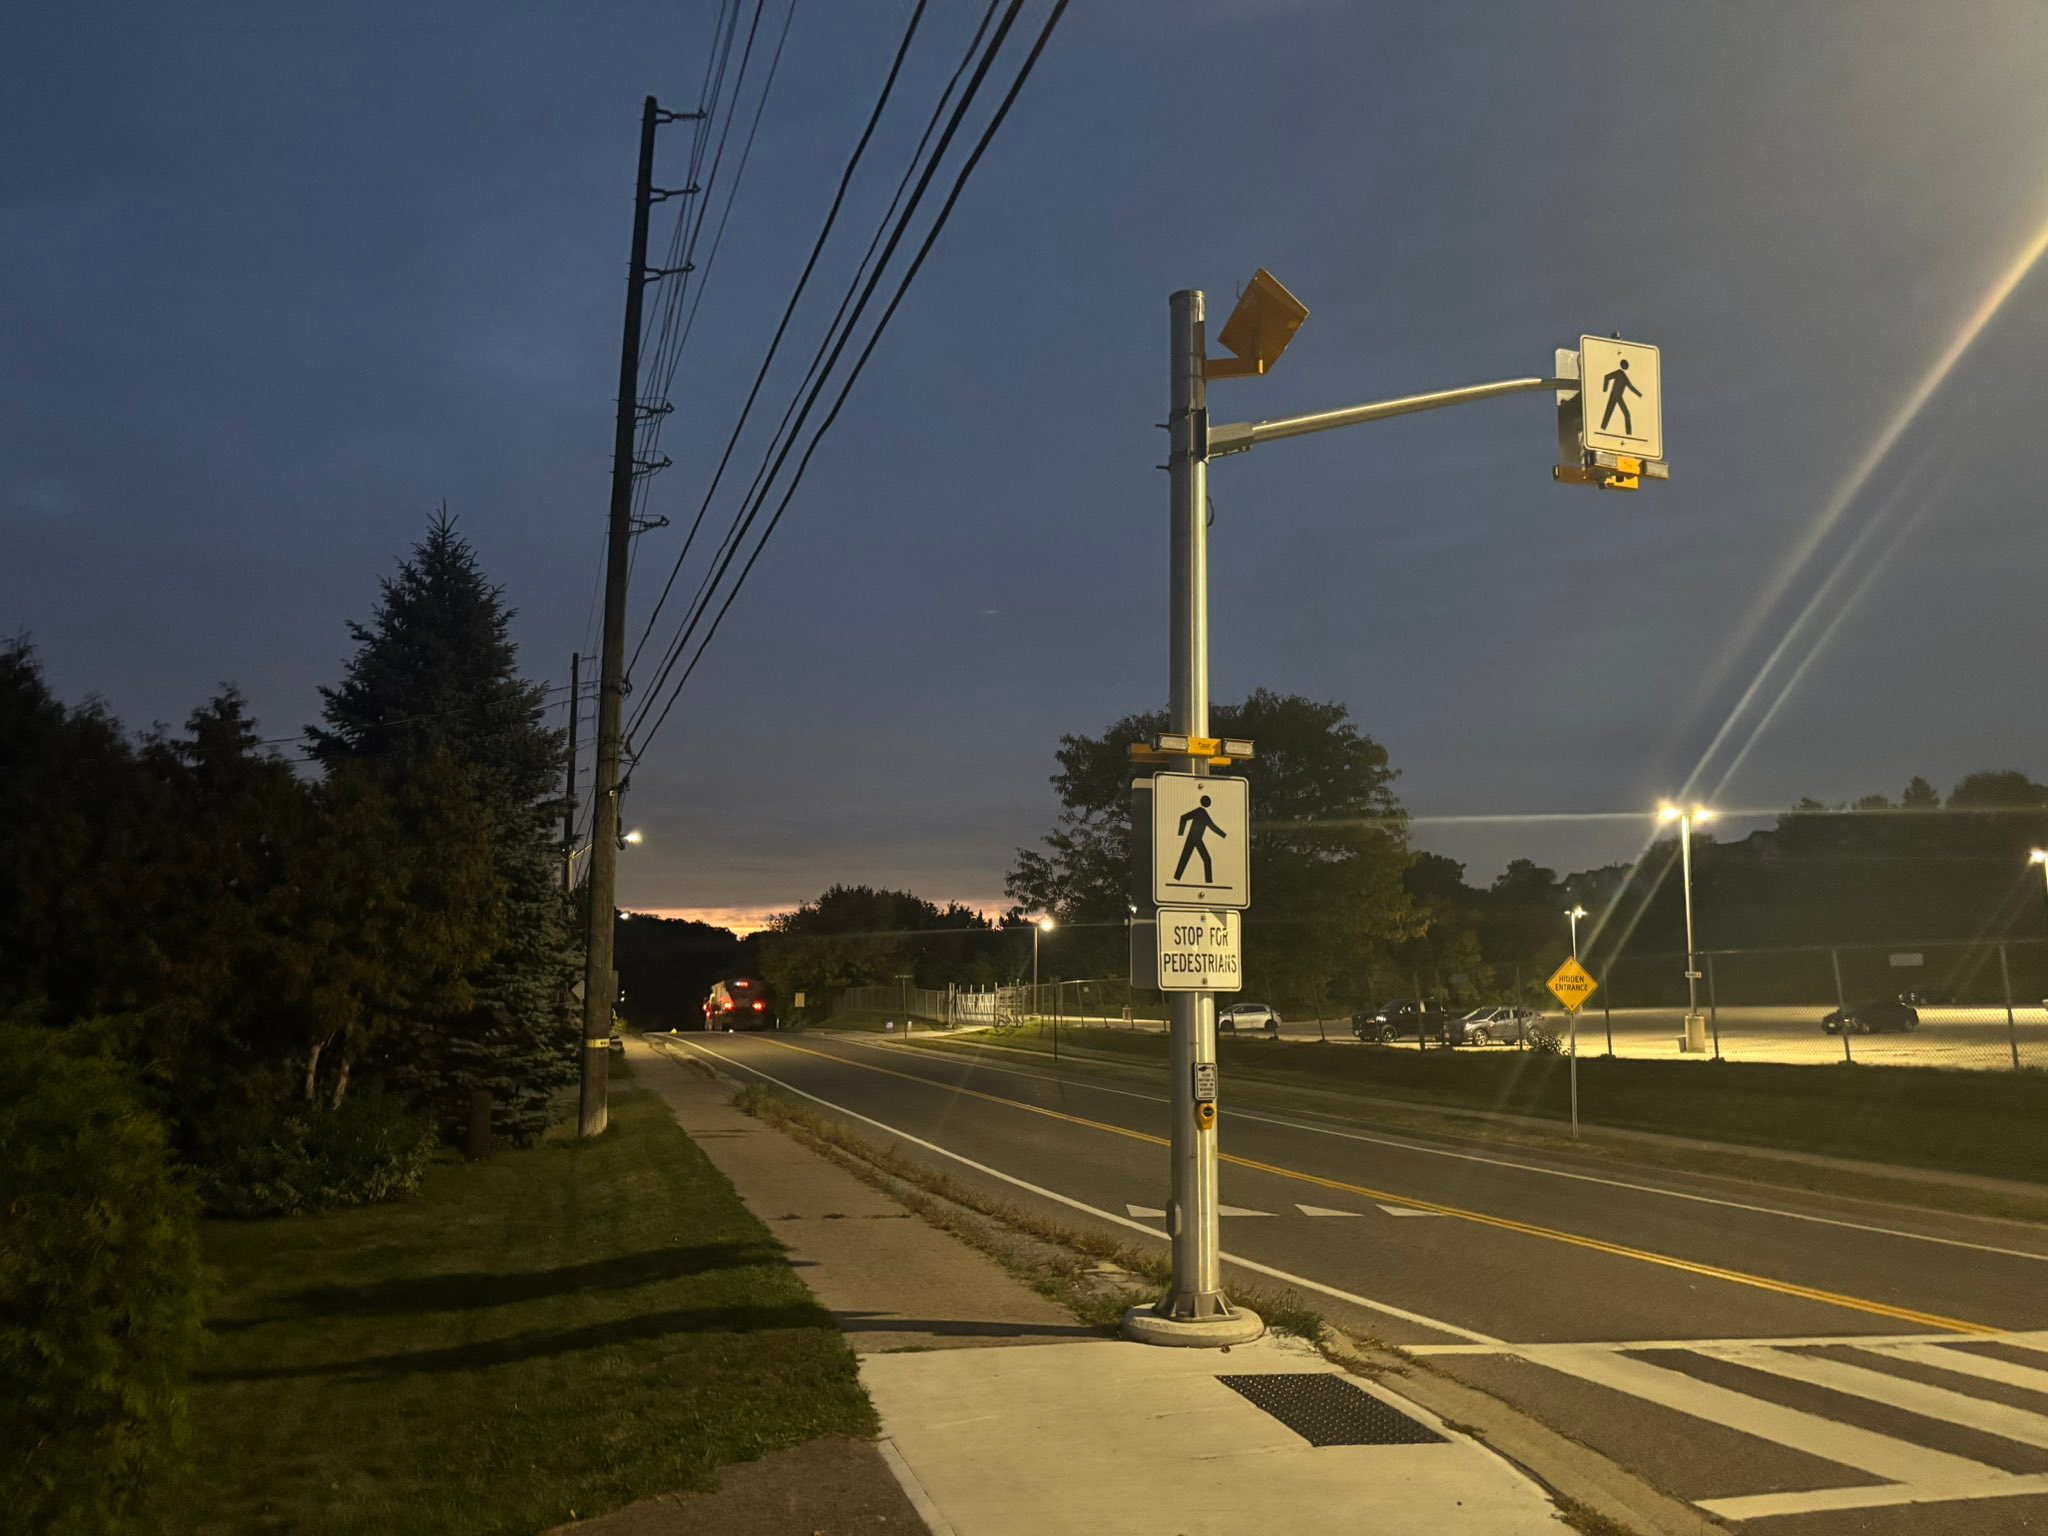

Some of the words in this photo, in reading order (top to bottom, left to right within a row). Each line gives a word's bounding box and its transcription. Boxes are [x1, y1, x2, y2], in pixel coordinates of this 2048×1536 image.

[1174, 926, 1203, 945] STOP
[1210, 927, 1229, 946] FOR
[1163, 953, 1237, 973] PEDESTRIANS
[1559, 975, 1584, 983] HIDDEN
